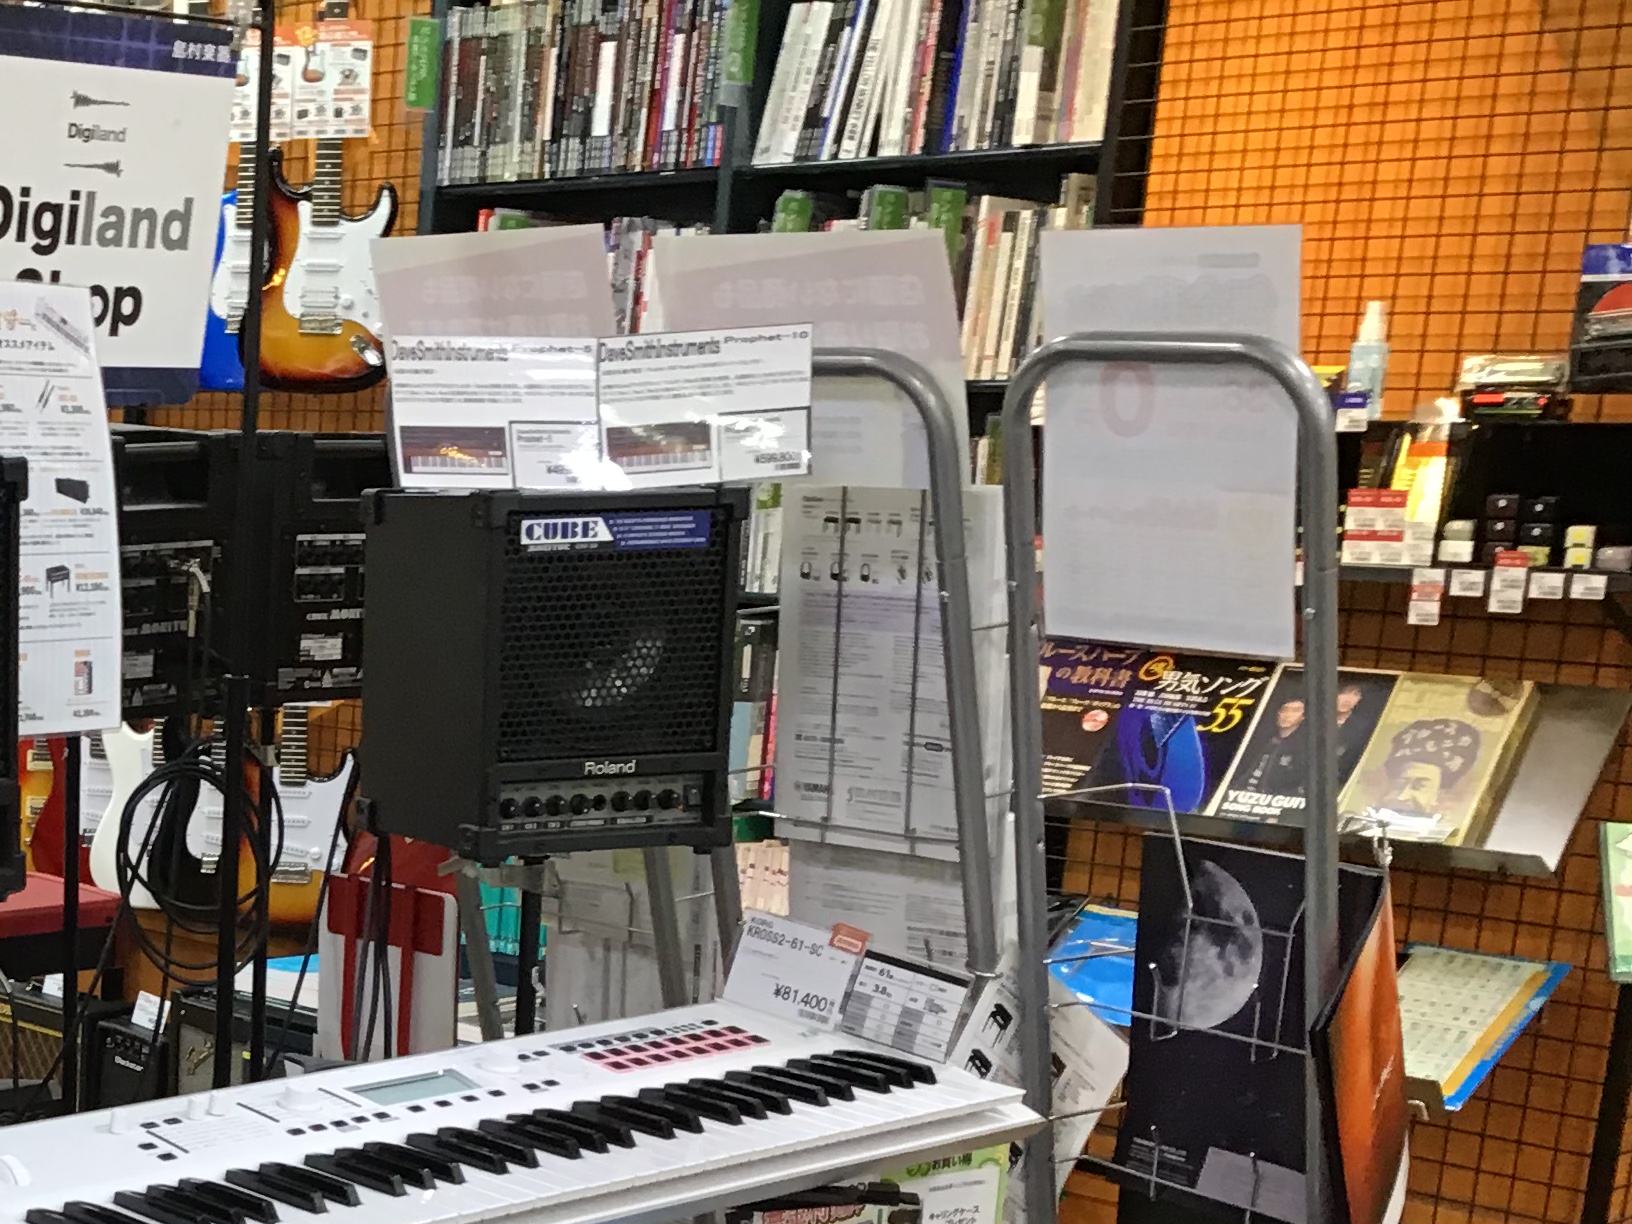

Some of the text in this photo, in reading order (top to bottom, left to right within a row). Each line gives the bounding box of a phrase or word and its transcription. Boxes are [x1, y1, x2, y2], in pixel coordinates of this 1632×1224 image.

[67, 122, 128, 143] Digiland
[524, 520, 600, 542] CUBE
[1055, 664, 1134, 689] の教科書
[1153, 669, 1271, 699] 男気ソング
[1195, 697, 1256, 733] 55
[583, 759, 637, 776] Roland
[1221, 801, 1252, 813] SONG
[1226, 788, 1273, 806] YUZU
[746, 924, 825, 958] KROSS2-61-SC
[773, 982, 828, 1013] ¥81,400
[929, 1204, 981, 1221] キャリングケース
